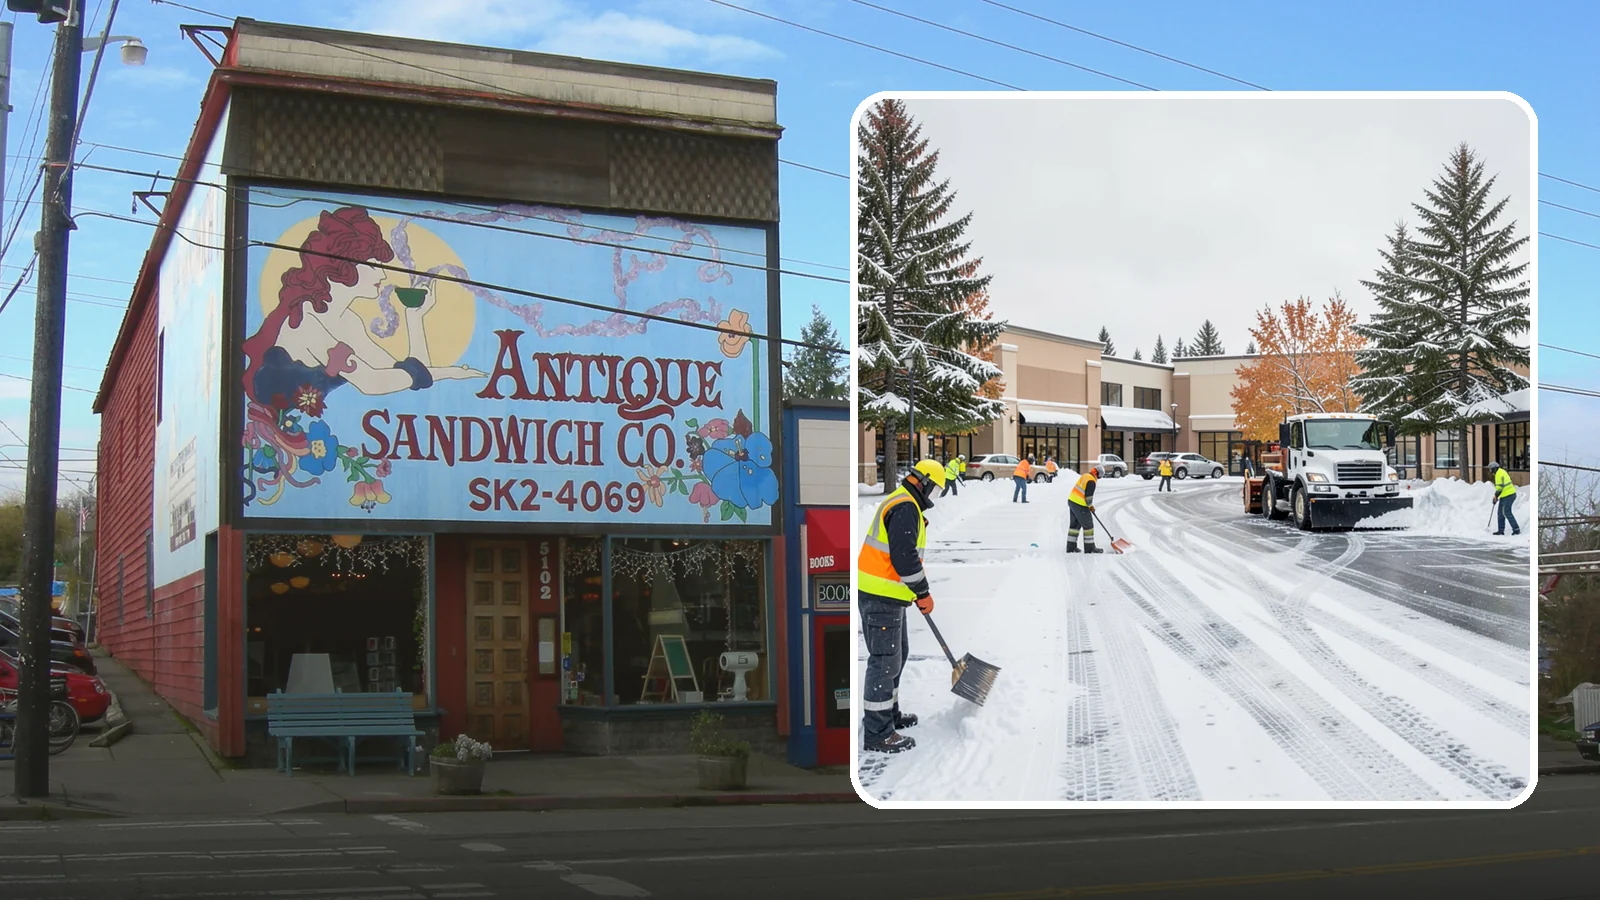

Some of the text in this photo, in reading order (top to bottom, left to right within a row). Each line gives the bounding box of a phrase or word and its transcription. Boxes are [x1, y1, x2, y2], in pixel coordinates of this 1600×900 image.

[476, 329, 724, 420] ANTIQUE
[362, 409, 685, 469] SANDWICH CO.
[469, 477, 645, 512] SK2-4069
[540, 542, 552, 600] 5102
[809, 555, 835, 569] BOOKS
